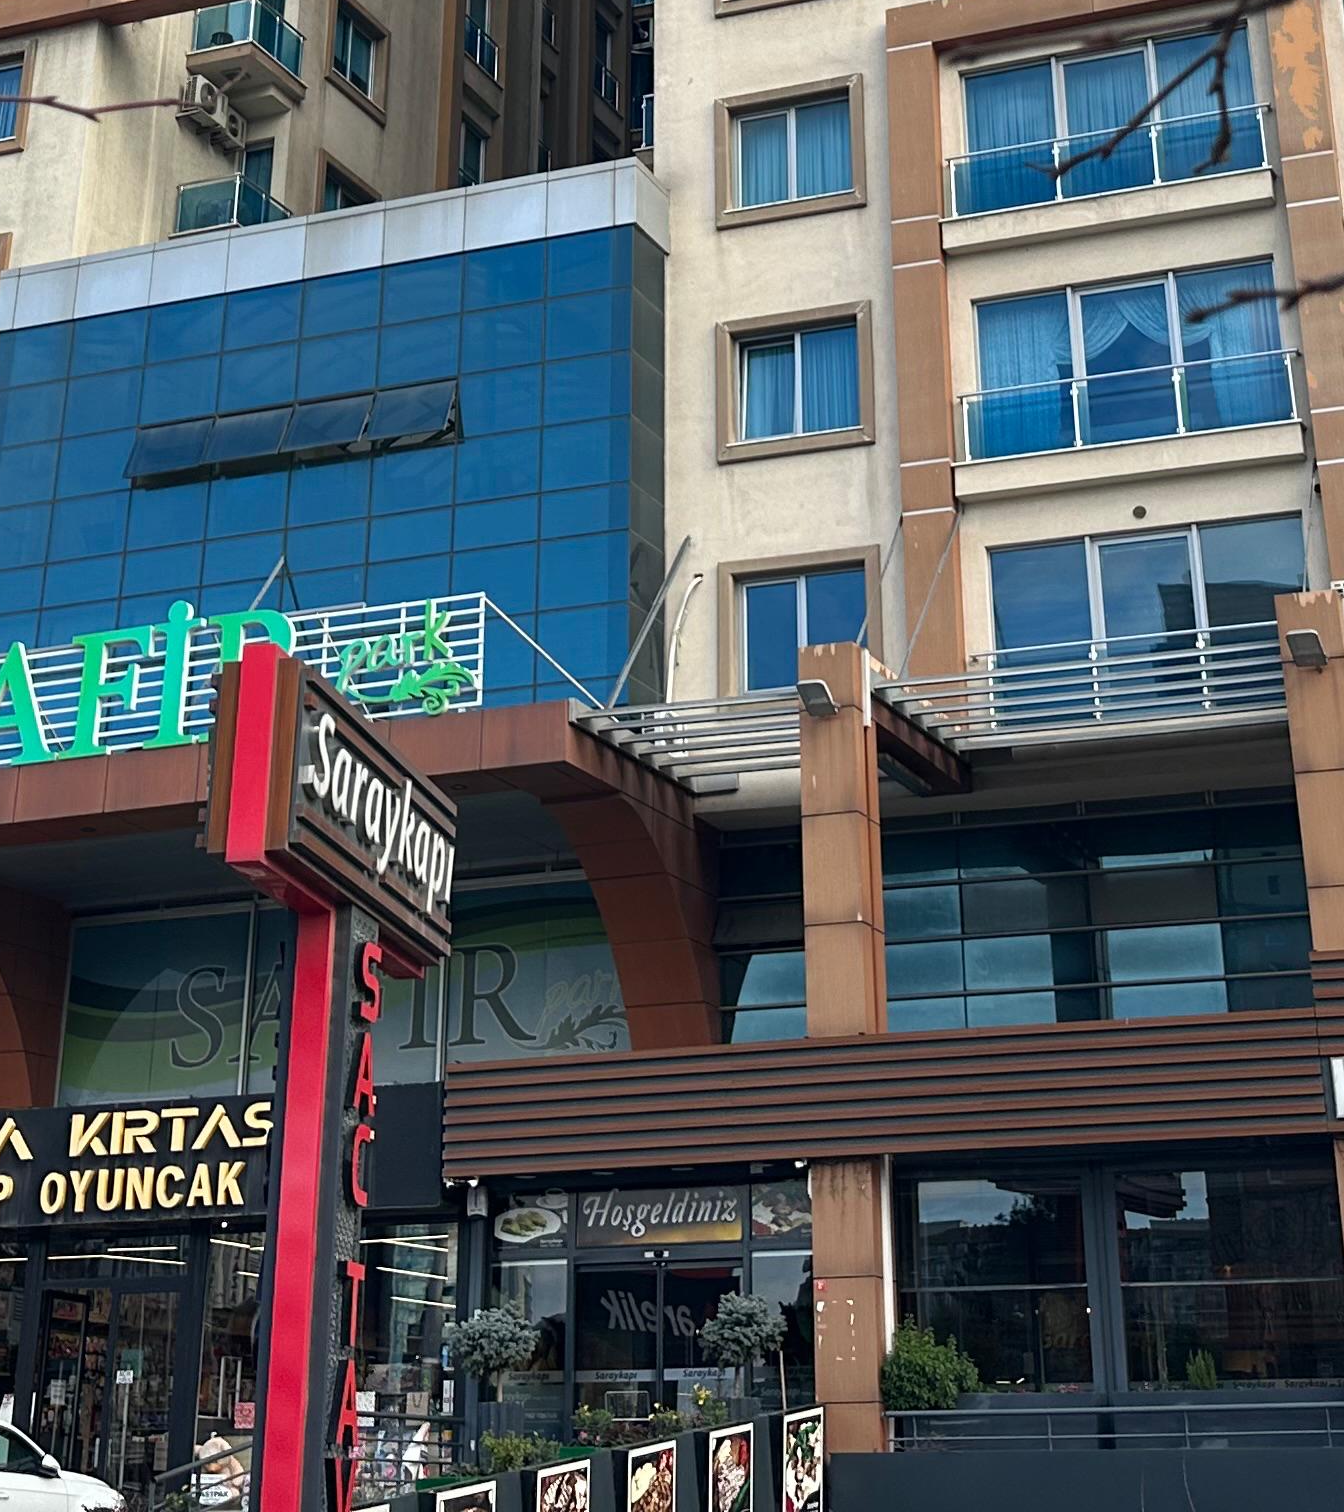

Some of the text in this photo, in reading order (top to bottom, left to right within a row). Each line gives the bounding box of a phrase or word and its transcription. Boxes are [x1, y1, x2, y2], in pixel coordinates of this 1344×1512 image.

[336, 598, 455, 692] park
[313, 713, 455, 915] Saraykapı
[40, 1161, 246, 1215] OYUNCAK
[583, 1188, 739, 1237] Hoşgeldiniz
